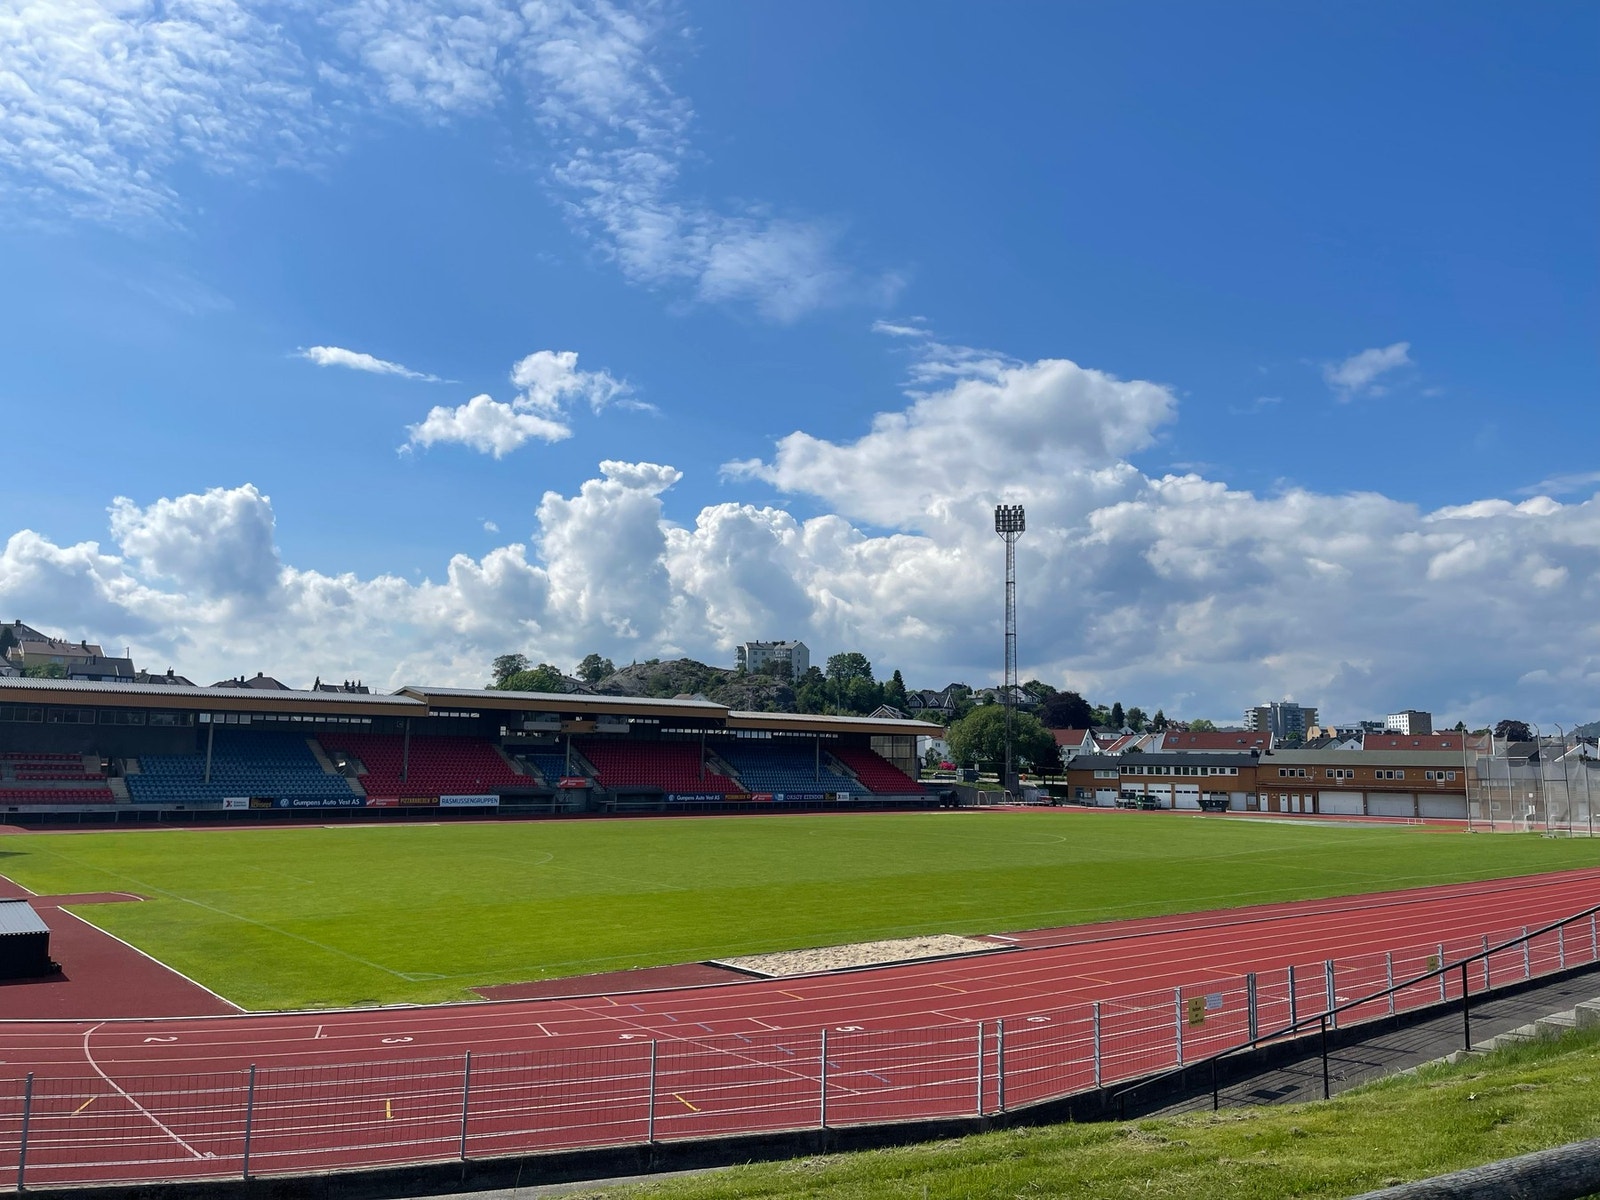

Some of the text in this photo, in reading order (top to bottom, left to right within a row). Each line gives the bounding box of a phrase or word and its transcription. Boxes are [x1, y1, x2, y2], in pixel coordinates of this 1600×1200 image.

[293, 798, 321, 808] Gumpens
[441, 797, 498, 805] RASMUSSENGRUPPEN
[381, 1036, 414, 1044] 3
